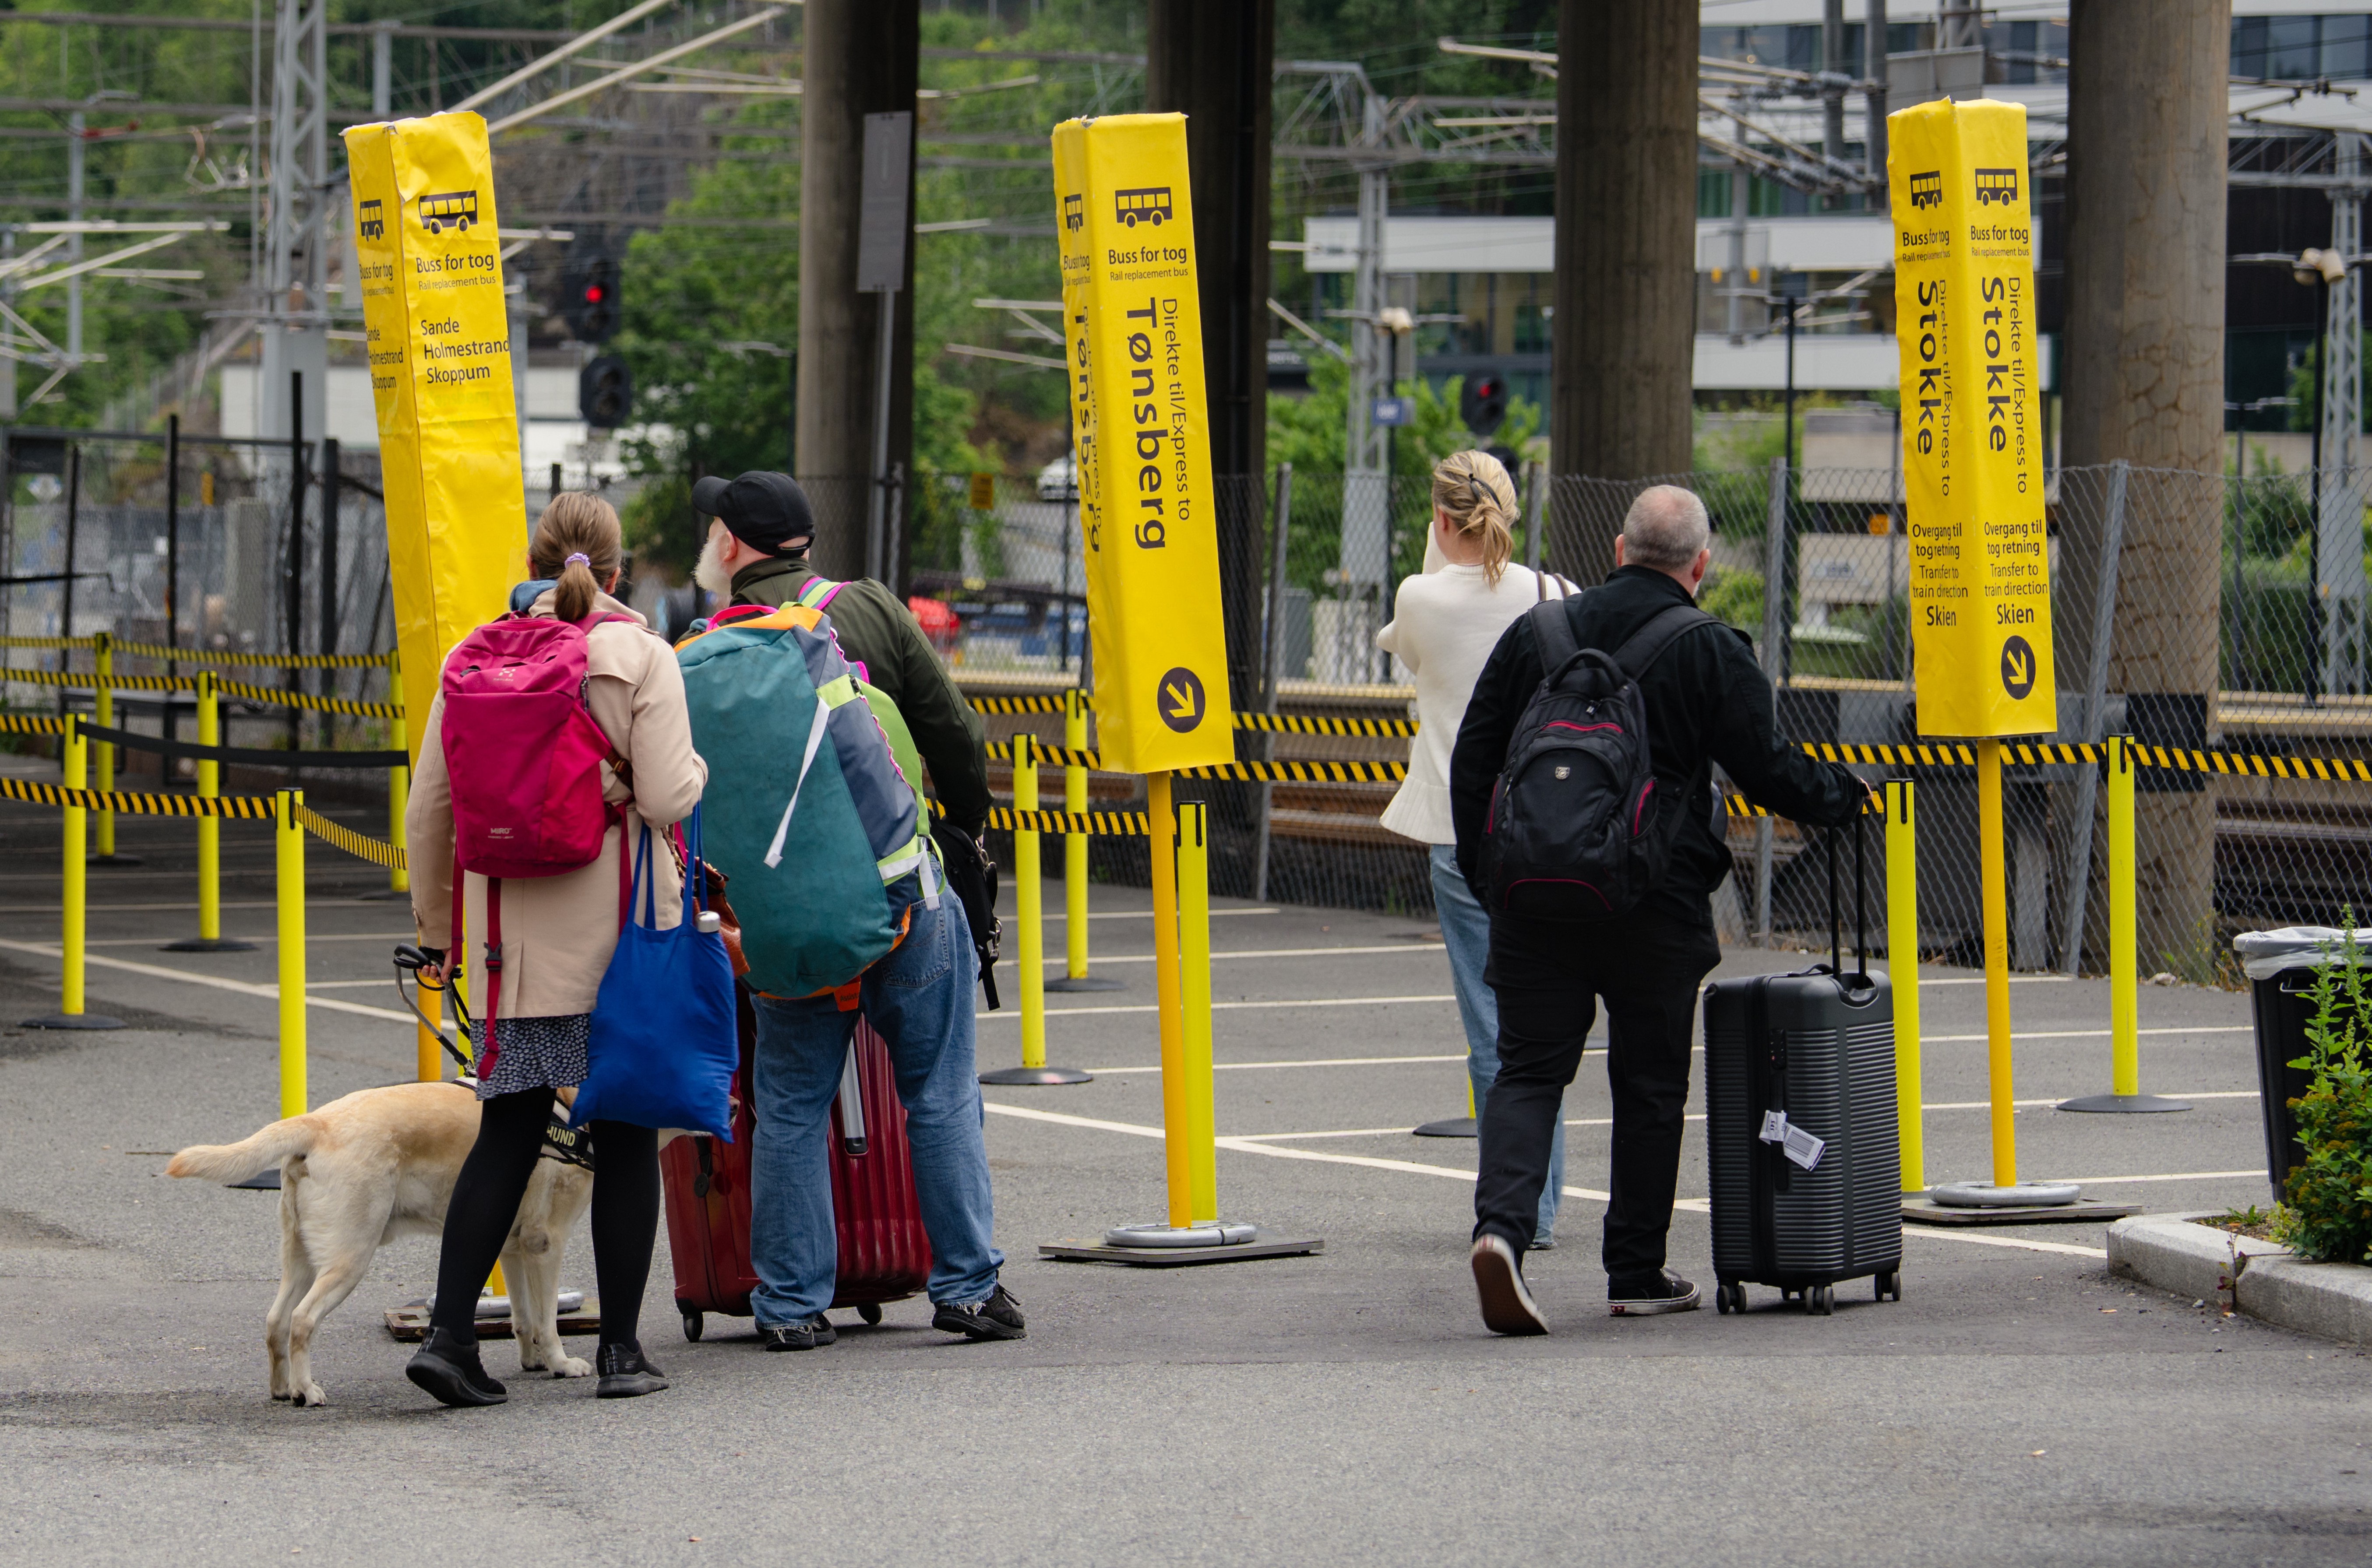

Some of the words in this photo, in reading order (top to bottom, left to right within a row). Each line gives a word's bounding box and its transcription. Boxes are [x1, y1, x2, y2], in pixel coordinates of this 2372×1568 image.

[1902, 232, 1928, 246] Buss
[1929, 229, 1938, 244] for
[1938, 229, 1949, 246] tog
[1970, 225, 1990, 241] Buss
[1992, 225, 2007, 240] for
[2009, 227, 2028, 244] tog
[1108, 250, 1137, 264] Buss
[1140, 246, 1159, 262] for
[1163, 247, 1187, 264] tog
[1903, 253, 1915, 263] Rail
[1917, 250, 1942, 262] replacement
[1971, 247, 1980, 256] Rail
[1981, 247, 2016, 258] replacement
[2017, 246, 2029, 256] bus
[373, 261, 382, 278] for
[383, 263, 393, 281] tog
[416, 257, 441, 273] Buss
[445, 253, 464, 271] for
[468, 254, 494, 271] tog
[1080, 254, 1090, 271] tog
[419, 279, 431, 290] Rail
[432, 276, 478, 291] replacement
[480, 274, 496, 285] bus
[1110, 271, 1123, 281] Rail
[1124, 269, 1172, 281] replacement
[1173, 267, 1188, 277] bus
[1939, 279, 1948, 355] Direkte
[2009, 277, 2022, 352] Direkte
[421, 317, 459, 336] Sande
[424, 335, 510, 359] Holmestrand
[1163, 299, 1181, 376] Direkte
[1917, 280, 1941, 455] Stokke
[1982, 277, 2010, 452] Stokke
[427, 366, 490, 386] Skoppum
[1941, 361, 1953, 468] til/Express
[2012, 358, 2025, 466] til/Express
[1127, 297, 1168, 549] Tønsberg
[1169, 381, 1188, 492] til/Express
[1942, 475, 1950, 496] to
[2017, 471, 2027, 493] to
[1096, 506, 1101, 528] to
[1178, 498, 1191, 520] to
[1913, 524, 1951, 541] Overgang
[1953, 522, 1962, 537] til
[1984, 522, 2028, 538] Overgang
[2031, 519, 2042, 534] til
[1916, 544, 1933, 559] tog
[1935, 542, 1960, 559] retning
[1988, 542, 1999, 558] tog
[2003, 539, 2040, 556] retning
[1919, 564, 1951, 579] Transfer
[1952, 567, 1959, 579] to
[1990, 562, 2024, 577] Transfer
[2028, 563, 2038, 576] to
[1913, 584, 1934, 598] train
[1937, 584, 1968, 598] direction
[1984, 583, 2002, 597] train
[2004, 581, 2048, 596] direction
[1927, 605, 1956, 626] Skien
[1997, 603, 2034, 624] Skien
